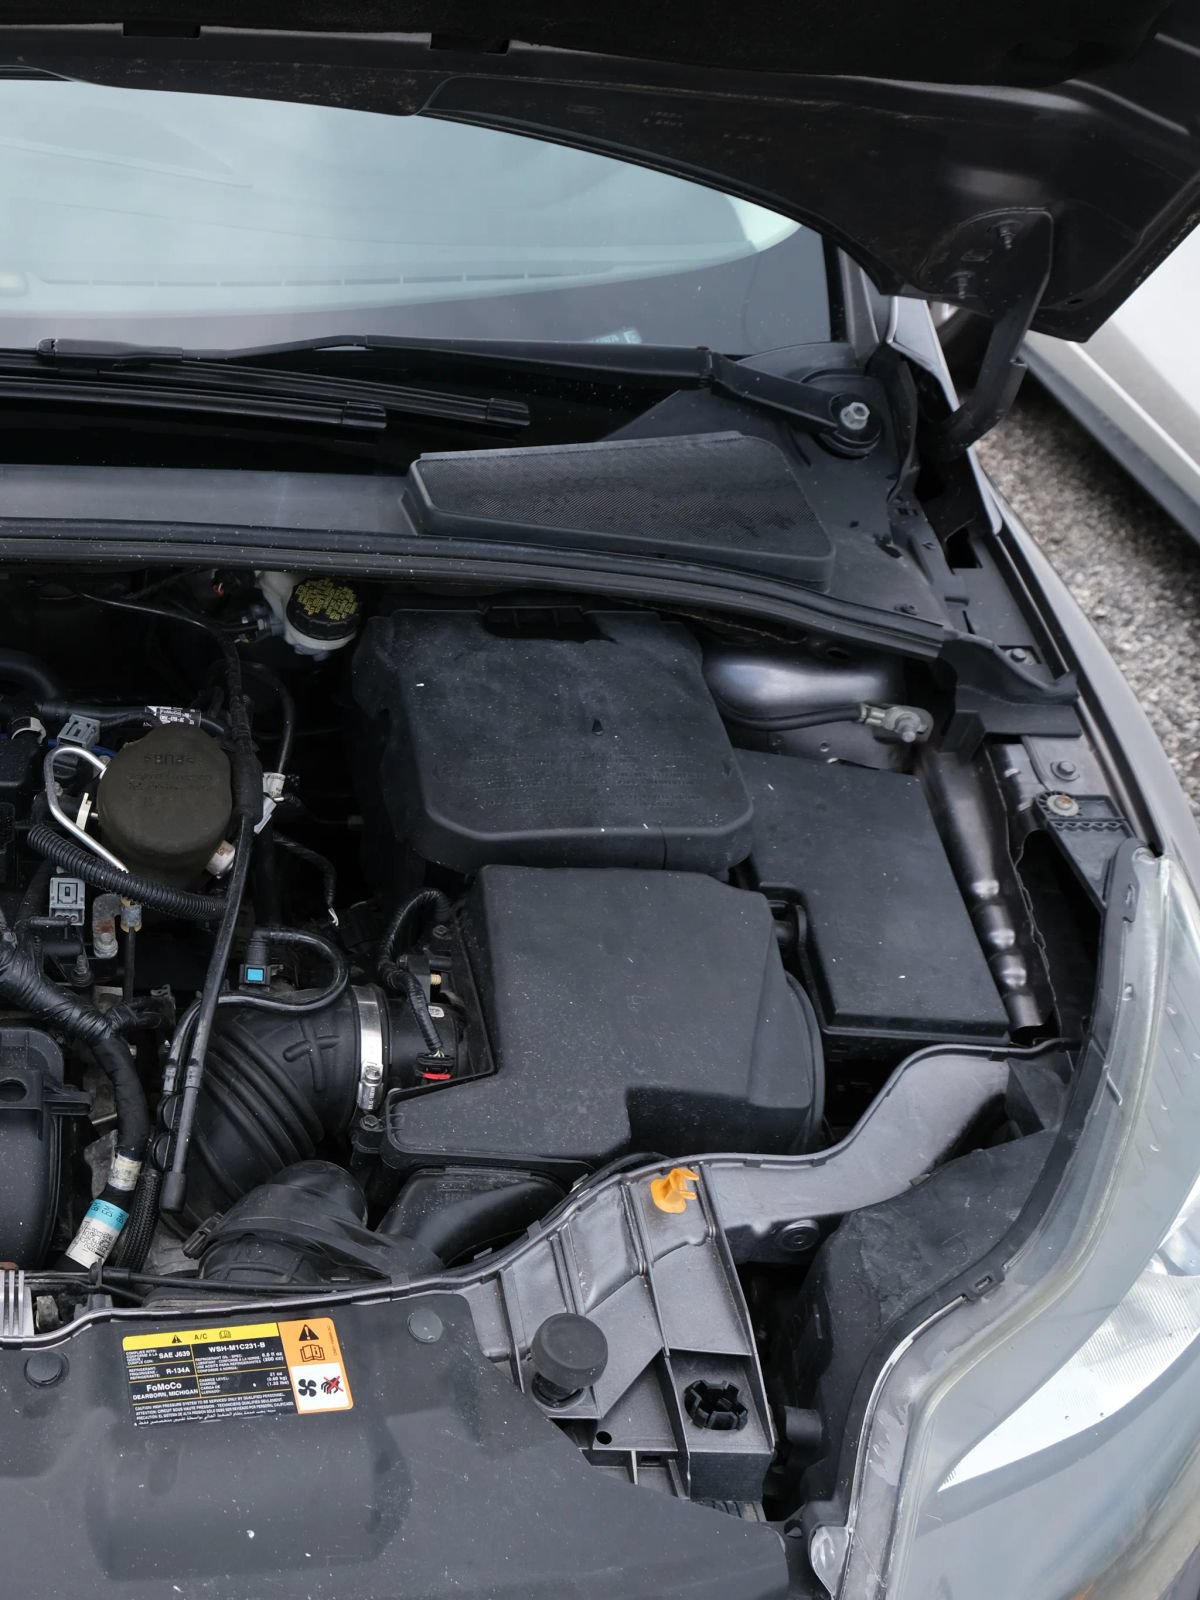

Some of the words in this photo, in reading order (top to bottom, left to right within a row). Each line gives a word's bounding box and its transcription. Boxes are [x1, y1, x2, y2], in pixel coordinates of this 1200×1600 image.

[208, 1342, 266, 1353] WSH-M1C231-B
[146, 1381, 182, 1392] FoMoCo
[133, 1392, 168, 1400] DEARBORN,
